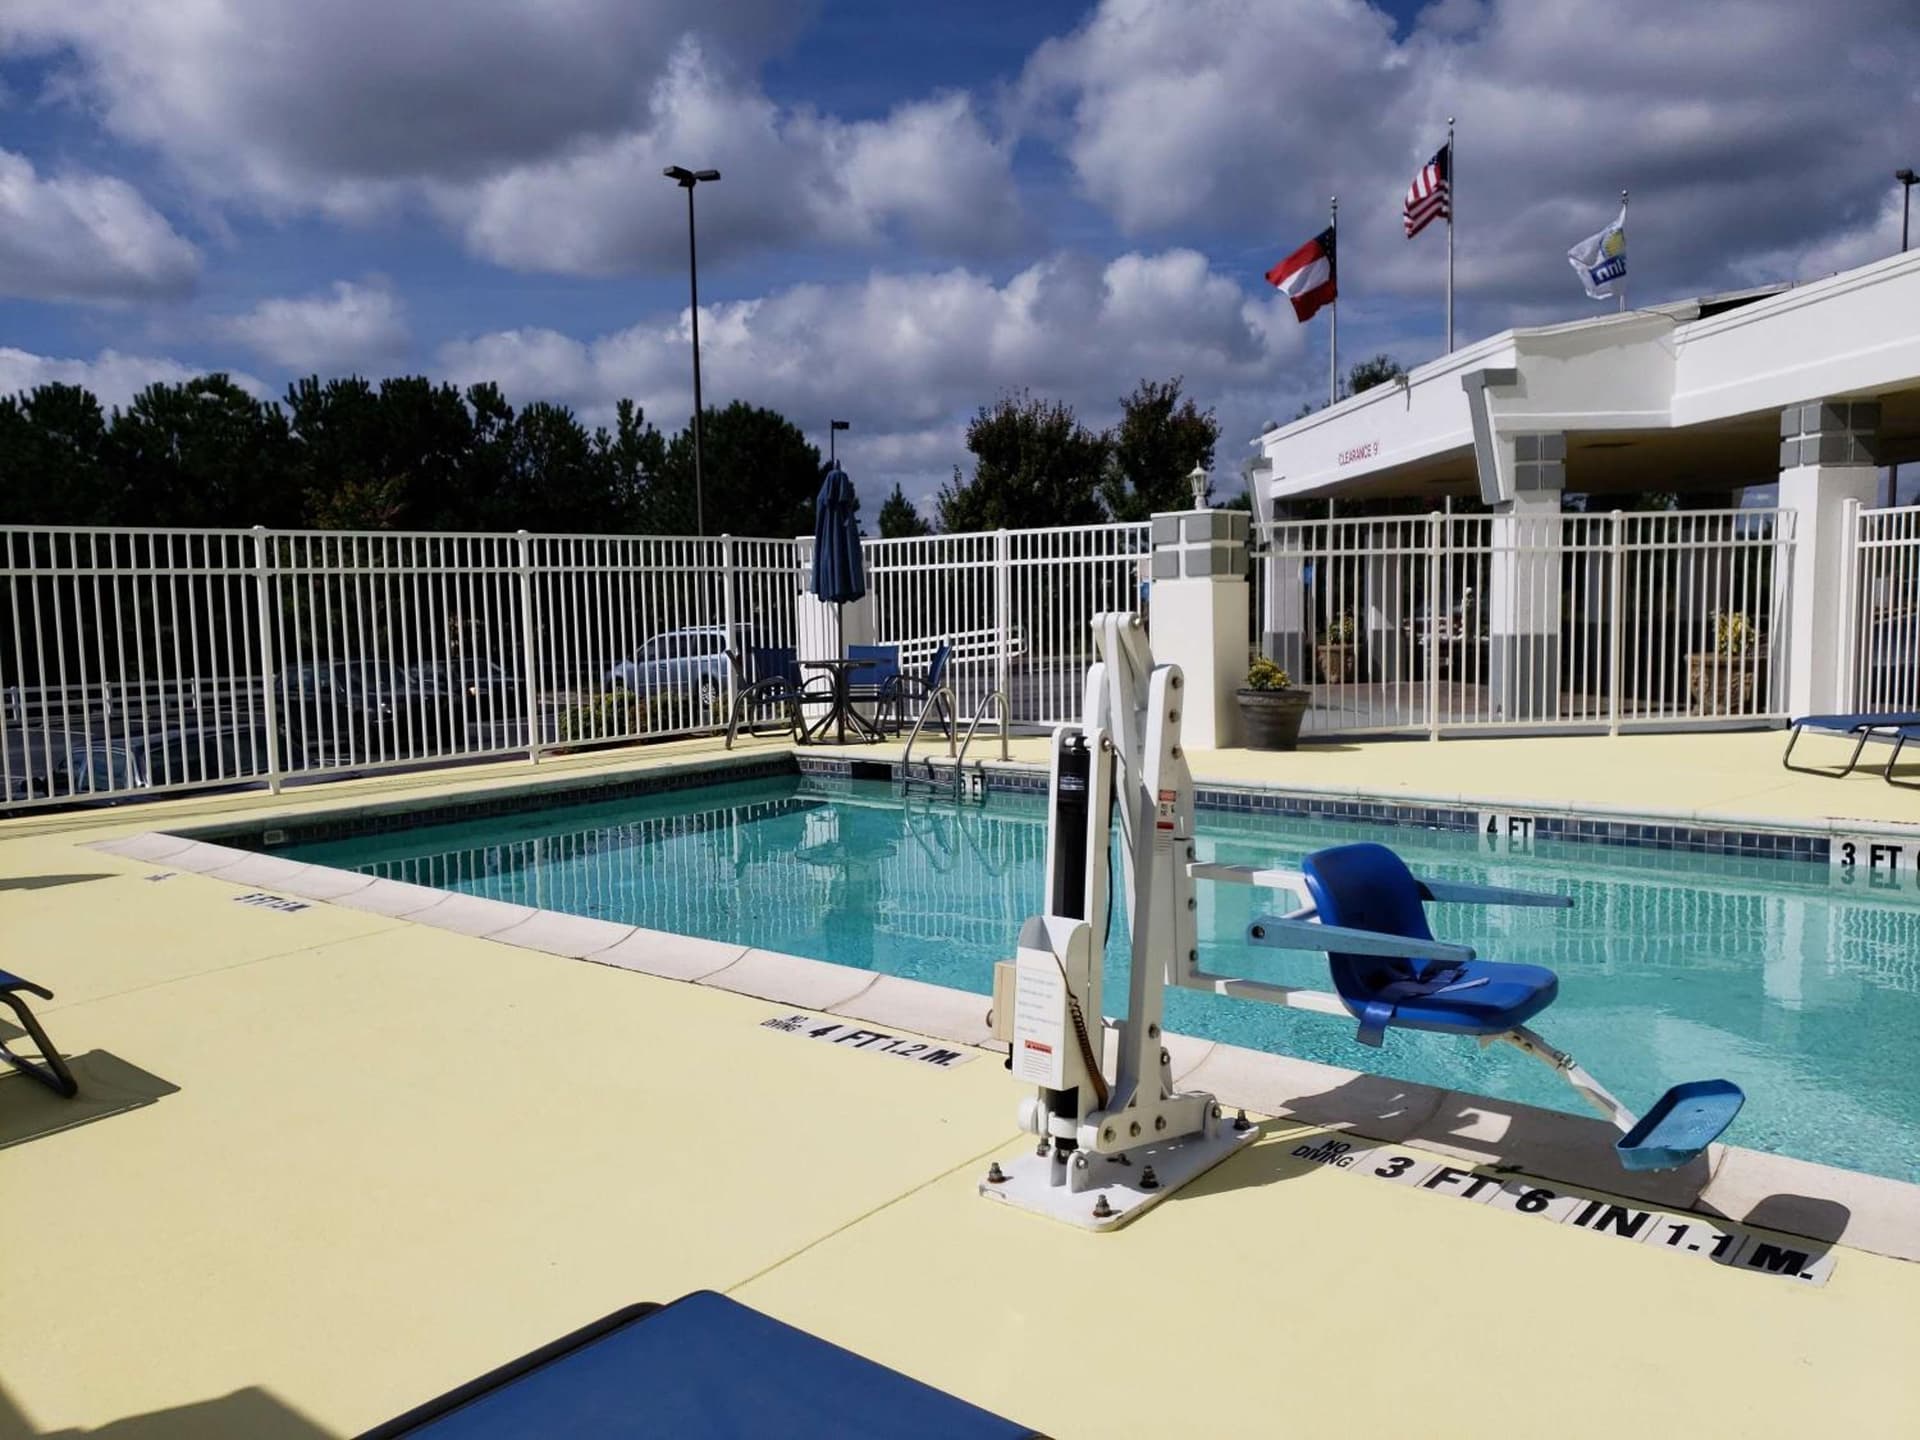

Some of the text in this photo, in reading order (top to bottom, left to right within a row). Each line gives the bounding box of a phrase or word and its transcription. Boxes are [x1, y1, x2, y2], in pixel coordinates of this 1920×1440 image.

[1338, 443, 1372, 466] CLEARANCE
[1487, 815, 1532, 837] 4 FT
[1841, 842, 1856, 865] 3
[1870, 844, 1903, 869] FT
[808, 1024, 844, 1038] 4
[833, 1030, 892, 1048] FT
[880, 1040, 928, 1056] 1.2
[1291, 1145, 1354, 1168] DIVING
[1319, 1140, 1352, 1154] NO
[1374, 1157, 1813, 1280] 3 FT 6 IN 1.1 M.
